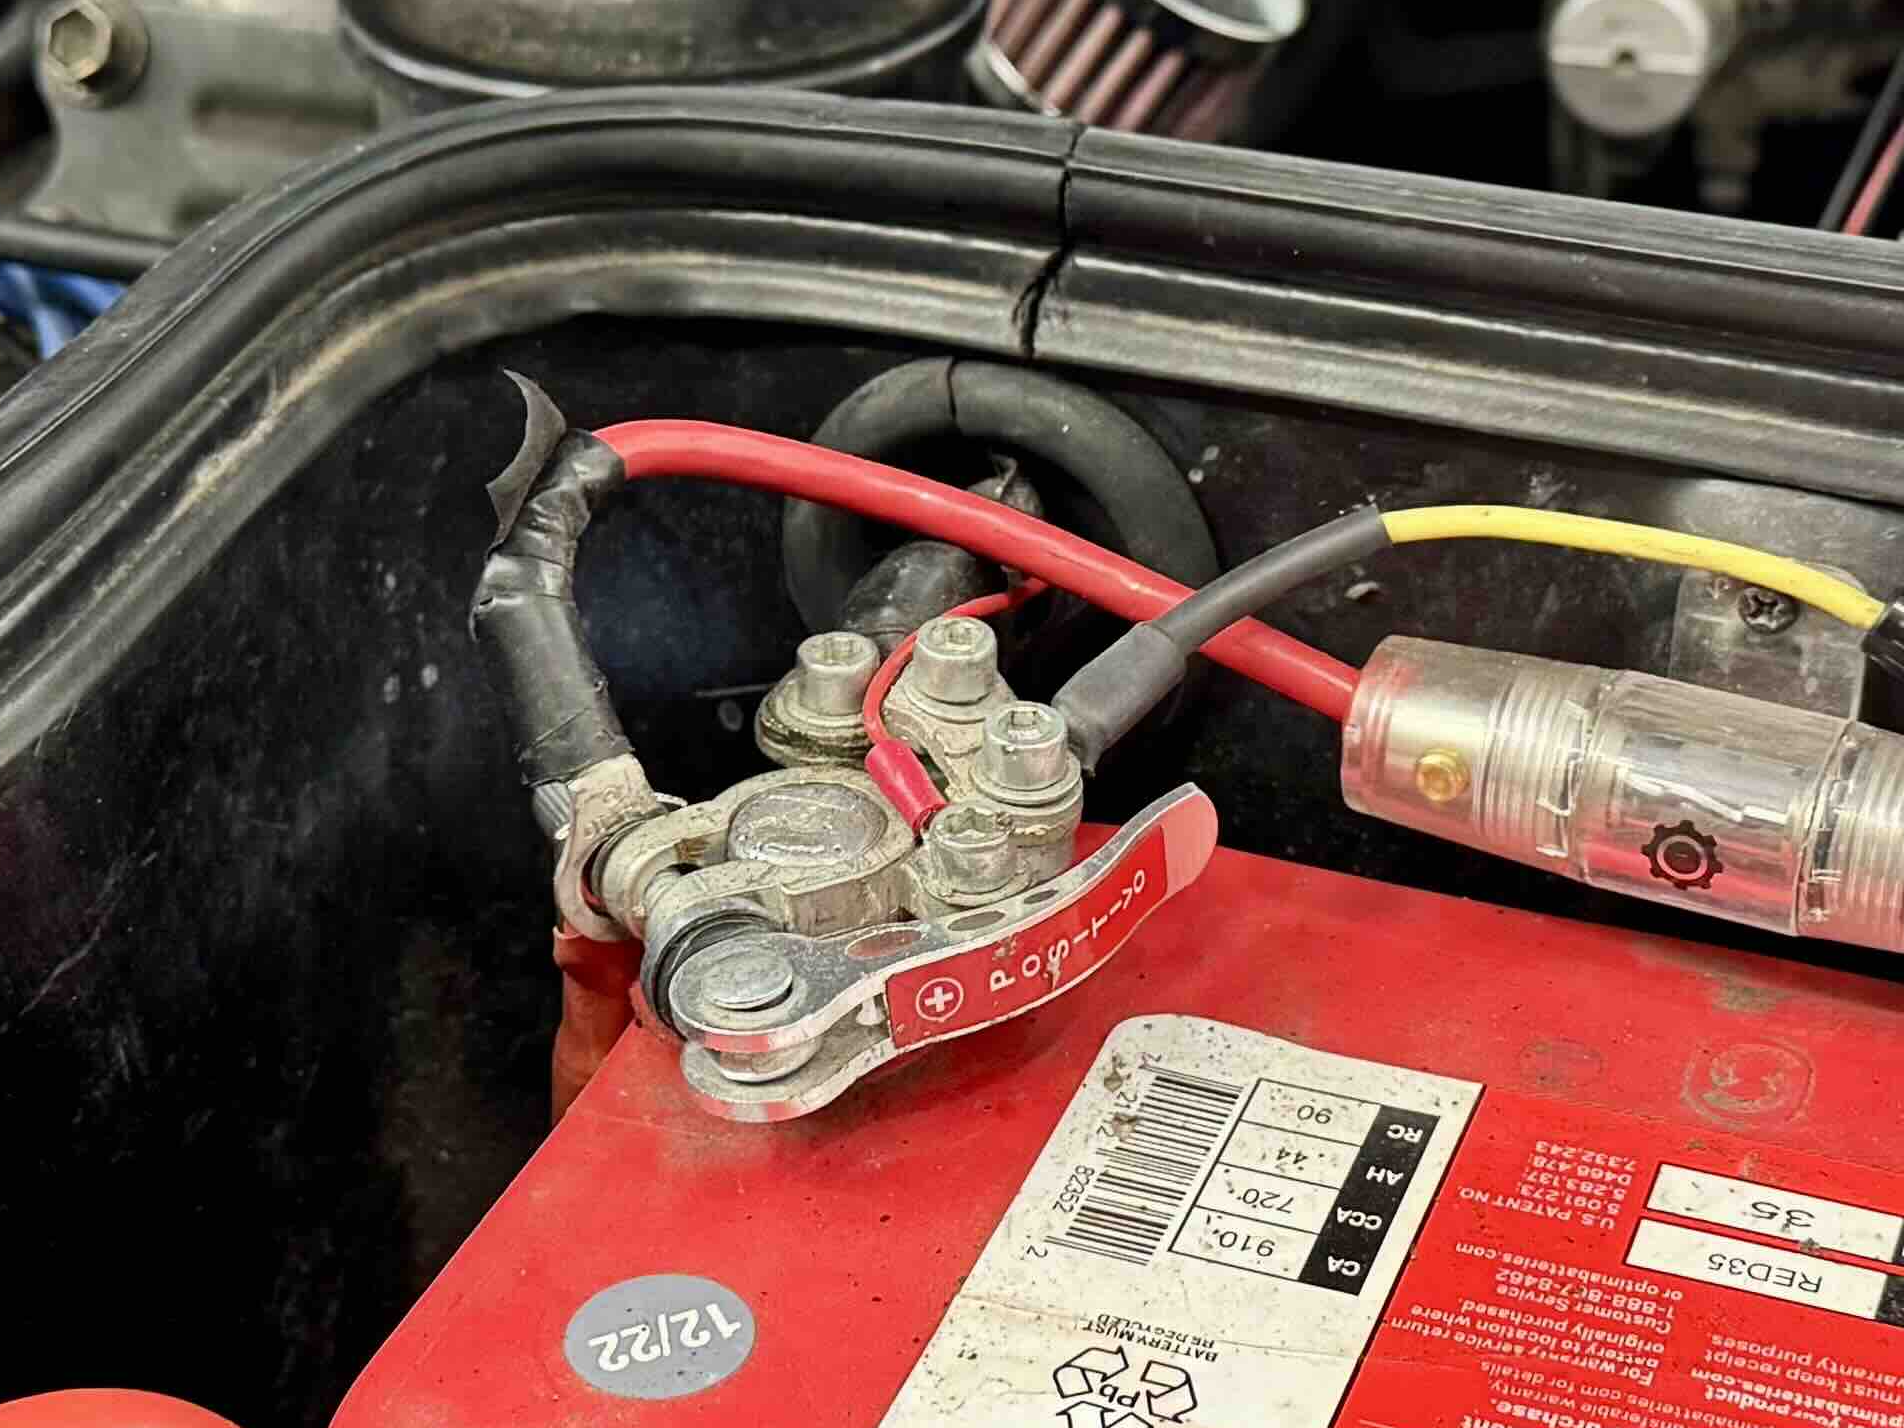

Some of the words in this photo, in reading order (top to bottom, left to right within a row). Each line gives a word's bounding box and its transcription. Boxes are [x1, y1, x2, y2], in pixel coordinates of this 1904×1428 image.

[989, 869, 1146, 992] POSITIVO
[1293, 1103, 1334, 1124] 90
[1384, 1122, 1424, 1143] RC
[1274, 1147, 1310, 1166] 44
[1049, 1163, 1098, 1214] 82352
[1363, 1164, 1404, 1186] AH
[1238, 1186, 1299, 1213] 720
[1452, 1185, 1488, 1202] NO.
[1490, 1193, 1572, 1220] PATENT
[1330, 1206, 1384, 1231] CCA
[1573, 1211, 1617, 1229] U.S.
[1744, 1199, 1817, 1229] 35
[1022, 1242, 1051, 1260] 2
[1214, 1228, 1278, 1257] 910
[1321, 1255, 1363, 1277] CA
[1452, 1237, 1660, 1298] optimabatteries.com
[1703, 1251, 1823, 1294] RED35
[1492, 1281, 1571, 1313] Service
[1660, 1287, 1683, 1302] or
[1389, 1315, 1451, 1340] return
[1408, 1303, 1473, 1327] where
[1453, 1294, 1569, 1334] purchased.
[1571, 1299, 1673, 1335] Customer
[586, 1302, 741, 1371] 12/22
[1081, 1319, 1137, 1342] MUST
[1451, 1329, 1525, 1357] service
[1472, 1317, 1558, 1348] location
[1568, 1321, 1666, 1357] originally
[1134, 1333, 1219, 1362] BATTERY
[1557, 1337, 1582, 1353] to
[1584, 1341, 1660, 1371] battery
[1526, 1343, 1617, 1376] warranty
[1701, 1346, 1783, 1379] receipt
[1548, 1376, 1576, 1392] for
[1617, 1363, 1655, 1386] For
[1783, 1365, 1839, 1391] keep
[1093, 1381, 1142, 1408] Pb
[1701, 1383, 1791, 1419] product
[1840, 1380, 1902, 1407] must
